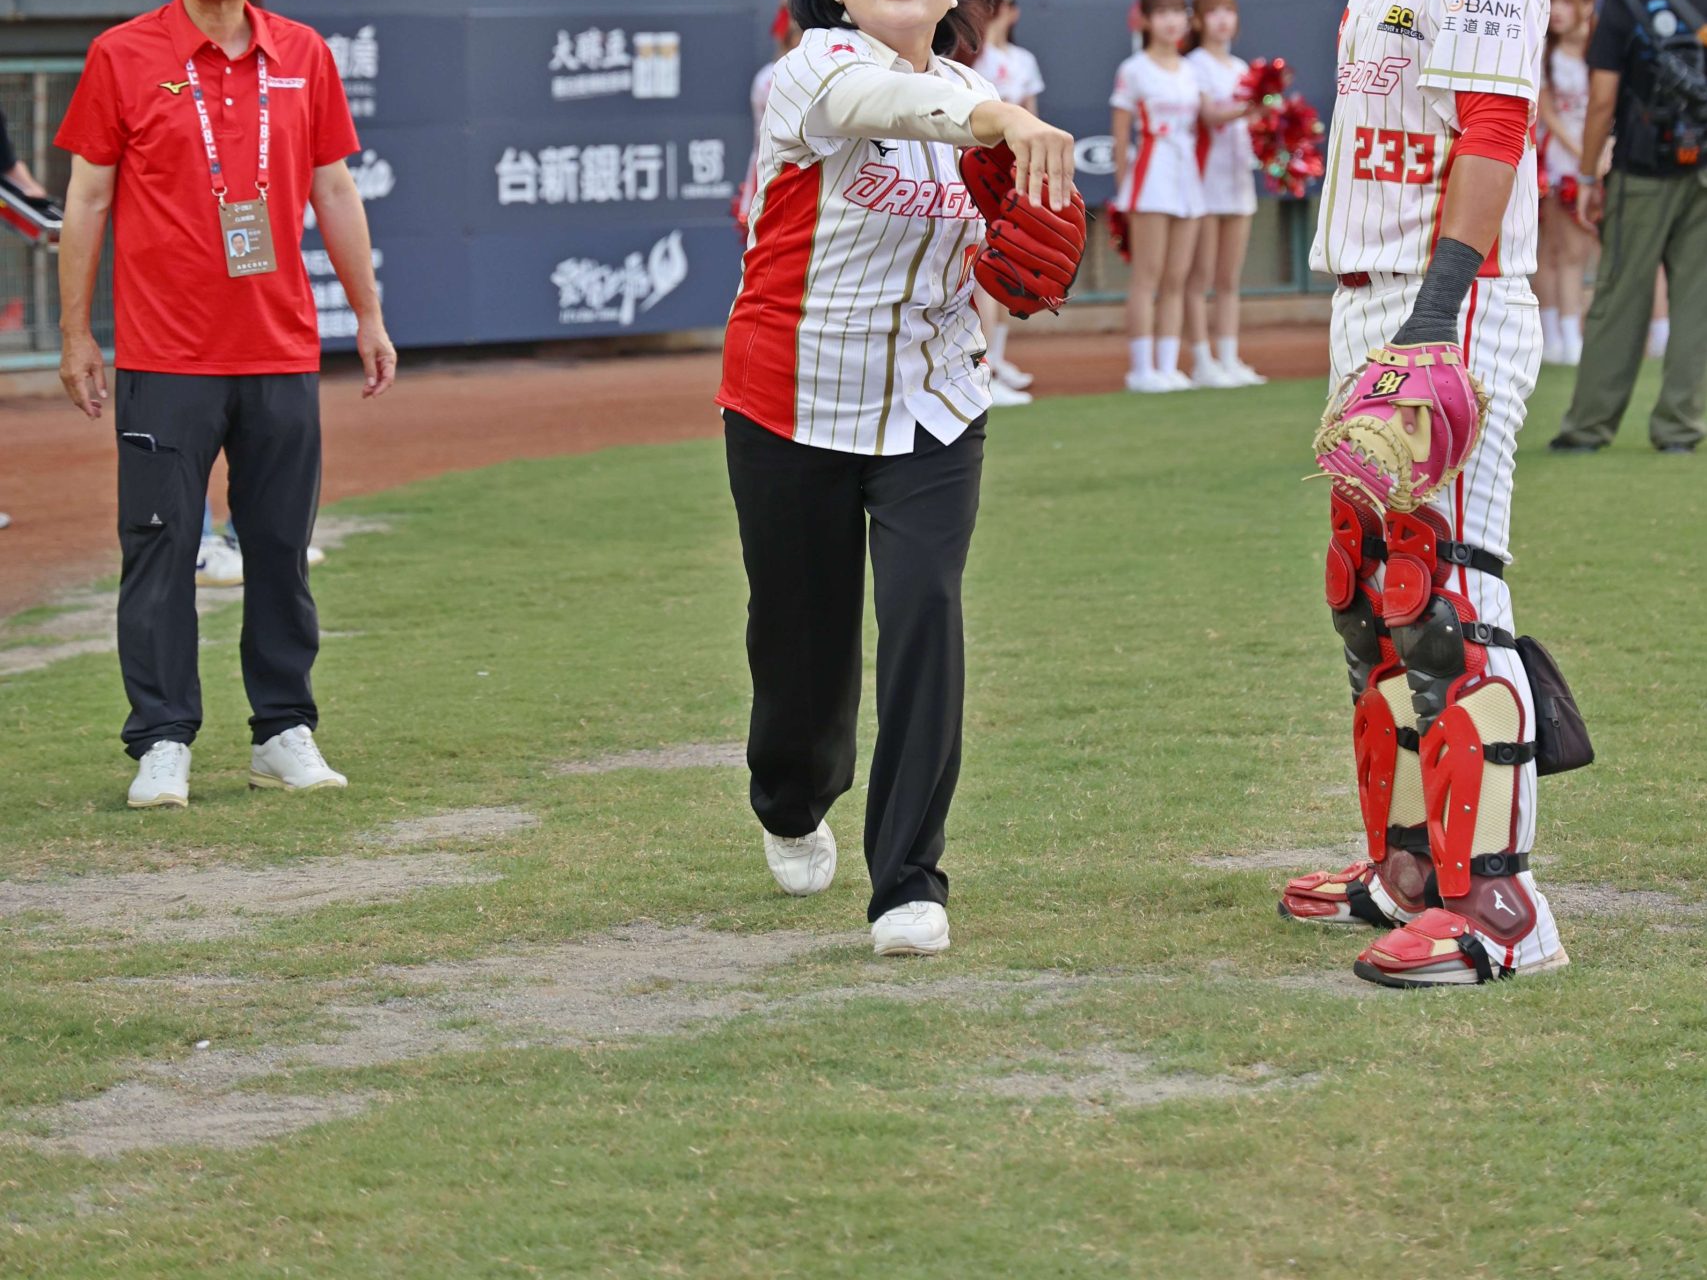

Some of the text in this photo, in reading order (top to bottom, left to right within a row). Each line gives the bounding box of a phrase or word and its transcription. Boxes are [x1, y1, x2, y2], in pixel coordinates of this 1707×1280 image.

[1384, 5, 1414, 28] BC
[1442, 17, 1521, 39] 王道銀行
[496, 143, 663, 204] 台新銀行
[1353, 126, 1436, 184] 233
